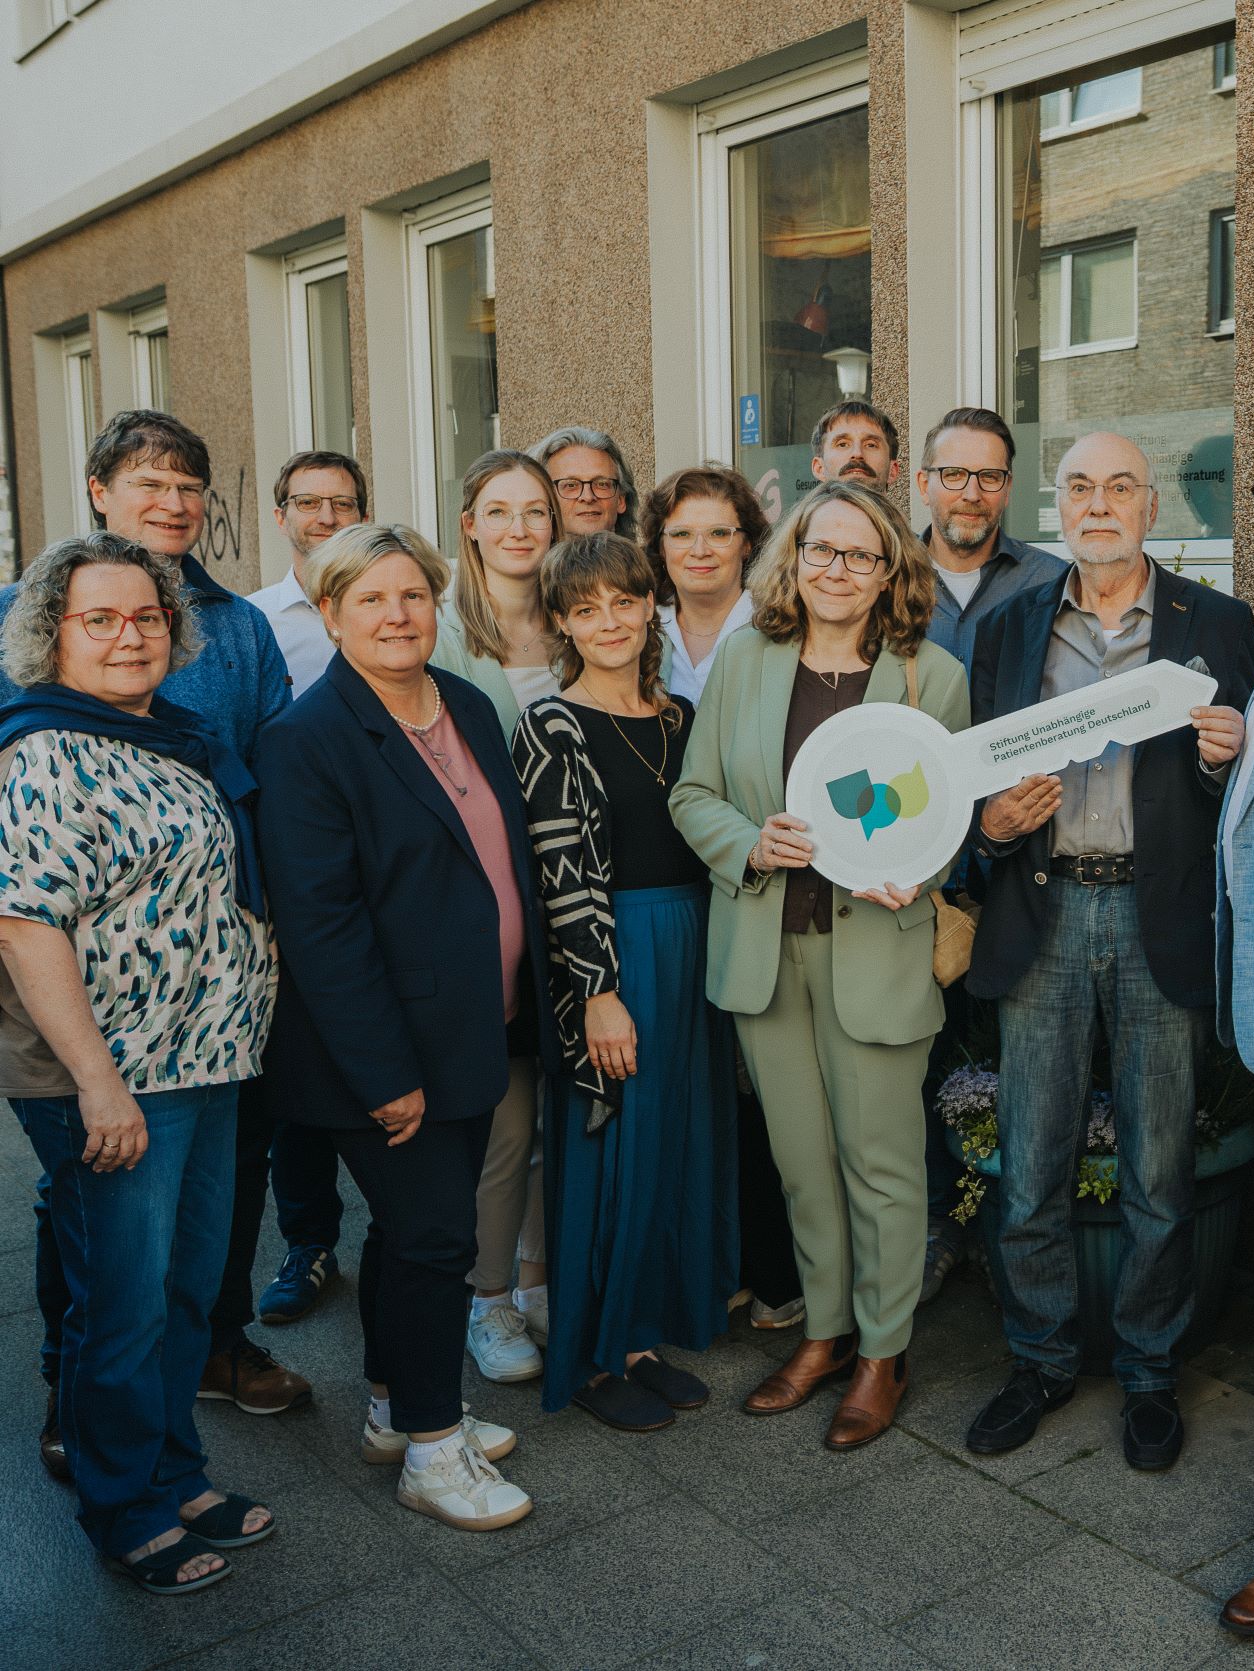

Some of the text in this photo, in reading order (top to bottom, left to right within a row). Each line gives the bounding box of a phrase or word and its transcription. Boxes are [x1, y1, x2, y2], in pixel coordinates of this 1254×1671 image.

[989, 707, 1096, 751] Stiftung Unabhängige
[993, 700, 1151, 763] Patientenberatung Deutschland
